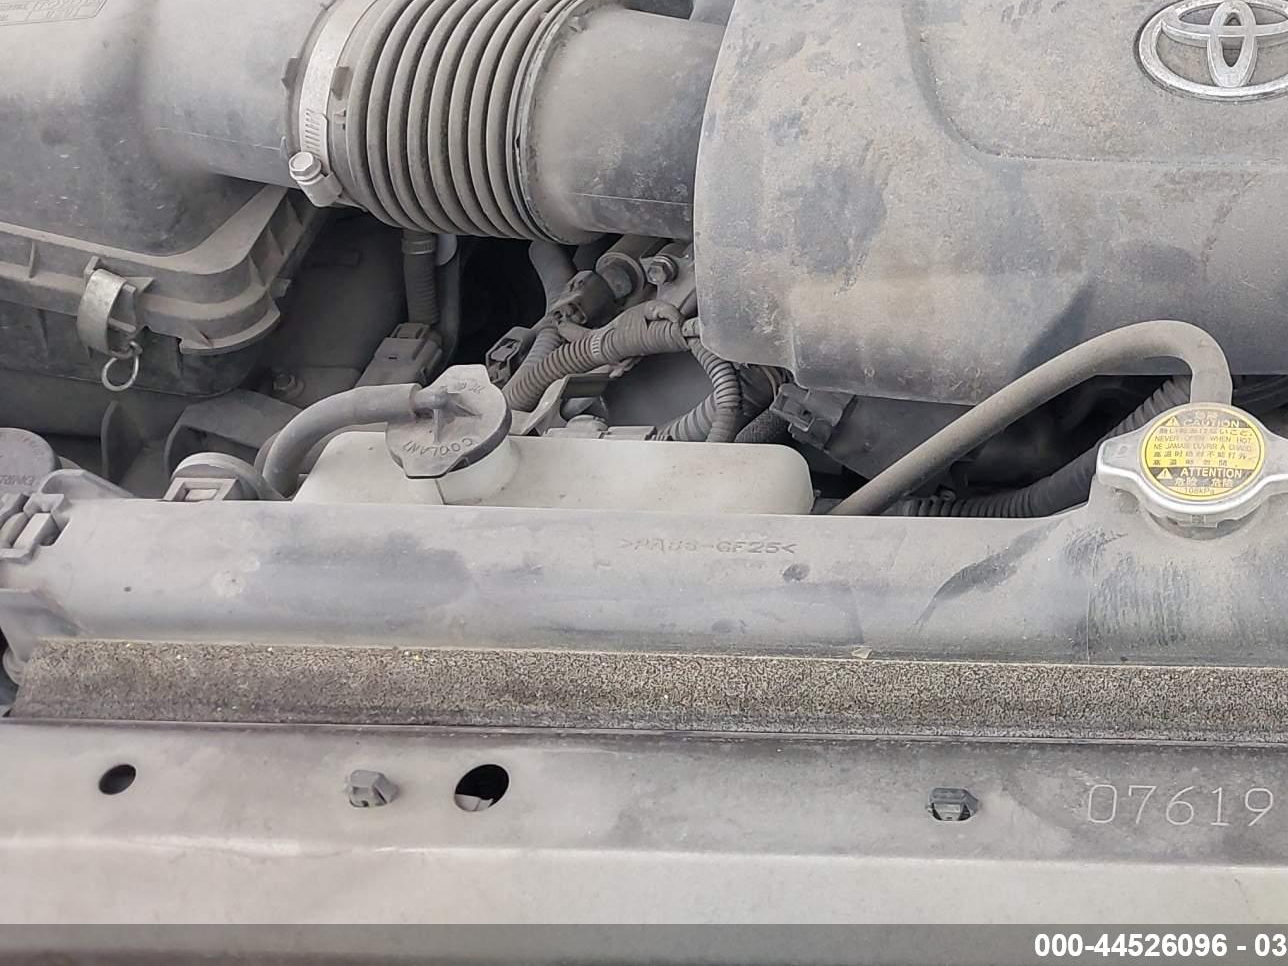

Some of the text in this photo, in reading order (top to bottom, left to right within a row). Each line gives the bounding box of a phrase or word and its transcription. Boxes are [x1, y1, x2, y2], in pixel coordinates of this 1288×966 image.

[1183, 419, 1240, 428] CAUTION
[1154, 435, 1179, 443] NEVER
[1210, 435, 1232, 443] WHEN
[402, 437, 475, 457] COOLANT
[1180, 467, 1242, 479] ATTENTION
[1086, 784, 1275, 827] 07619
